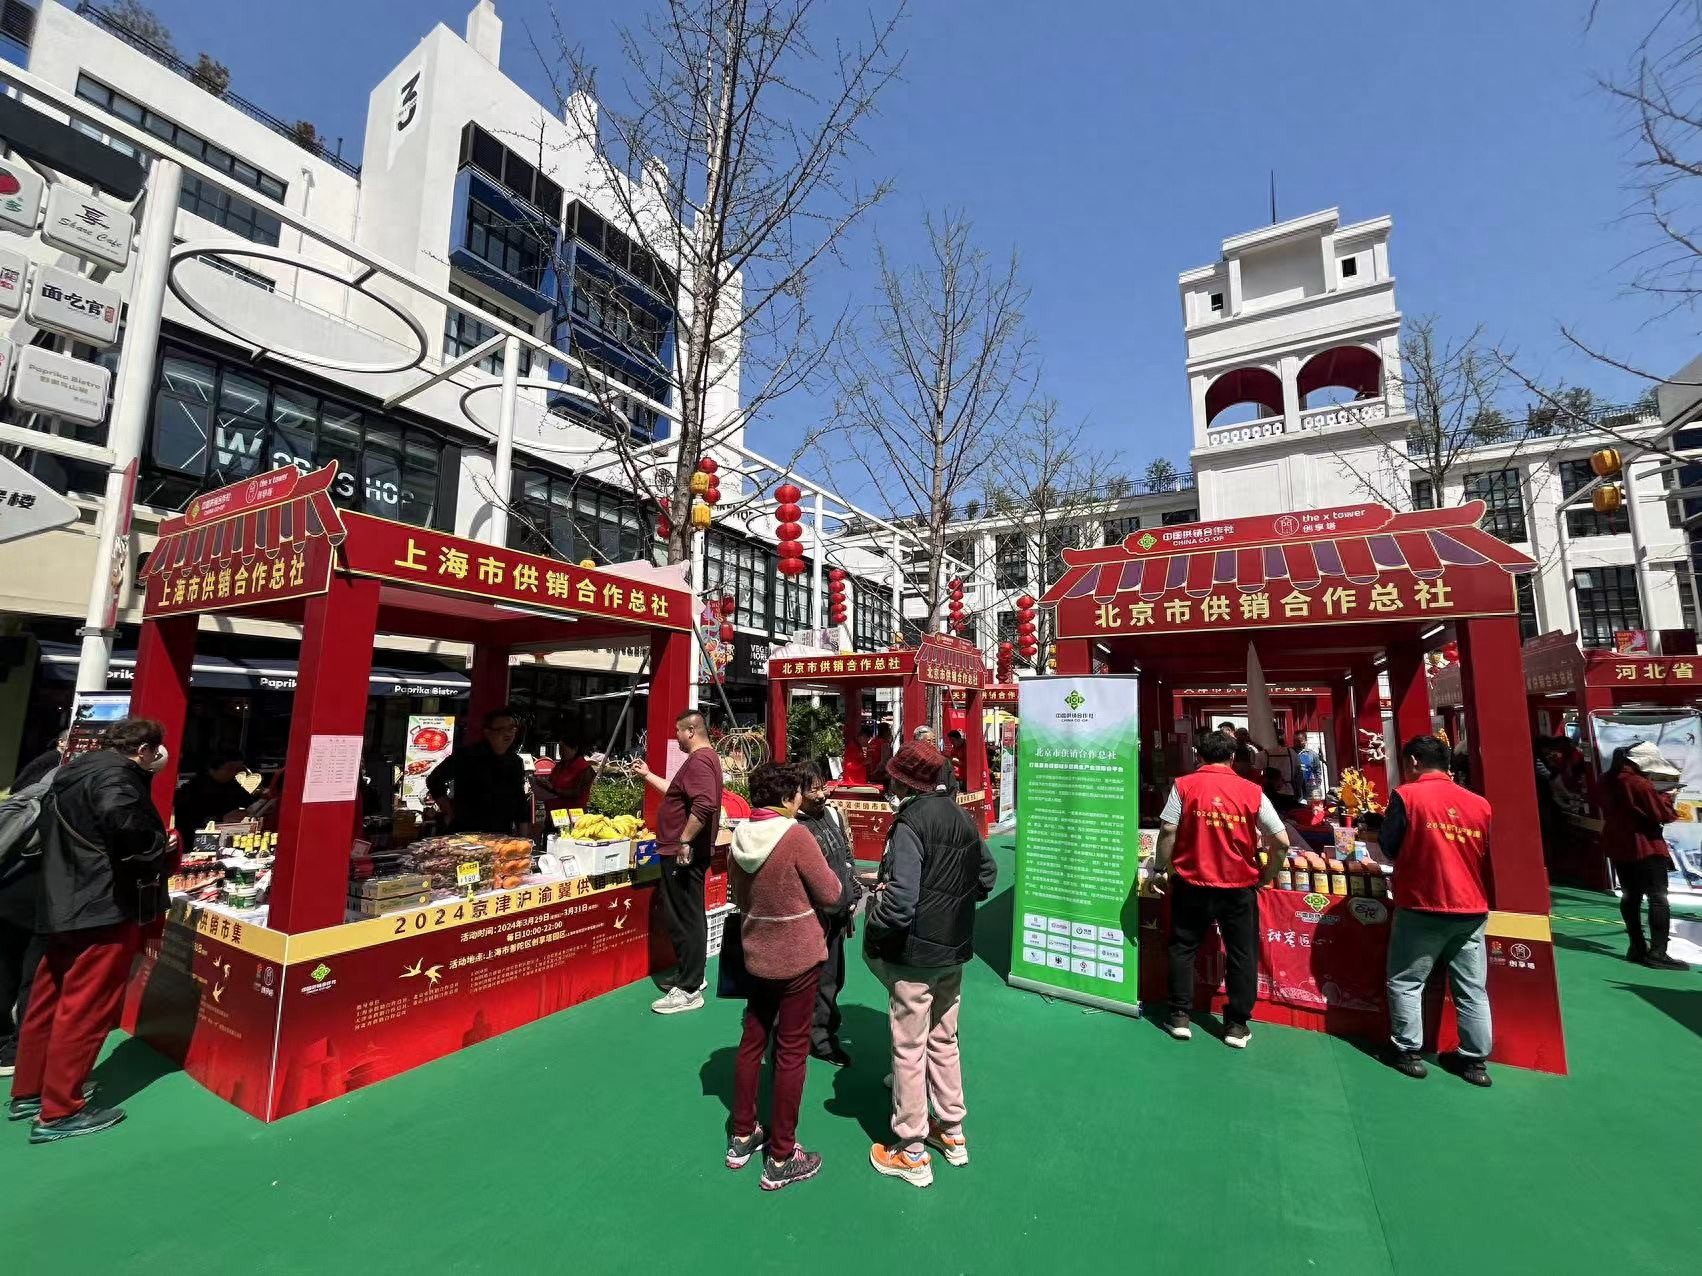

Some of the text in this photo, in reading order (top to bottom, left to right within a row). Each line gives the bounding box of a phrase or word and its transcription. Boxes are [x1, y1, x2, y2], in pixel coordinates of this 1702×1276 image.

[41, 283, 104, 316] 面吃官
[1302, 514, 1320, 523] the
[1332, 508, 1366, 519] tower
[1162, 524, 1235, 542] 中国供销合作社
[1302, 522, 1337, 534] 创享塔
[1172, 538, 1197, 547] CHINA
[157, 553, 306, 608] 上海市供销合作总社
[395, 537, 670, 619] 上海市供销合作总社
[1094, 578, 1455, 629] 北京市供销合作总社
[782, 656, 901, 675] 北京市供销合作总社
[1616, 663, 1694, 680] 河北省
[394, 685, 430, 695] Paprika
